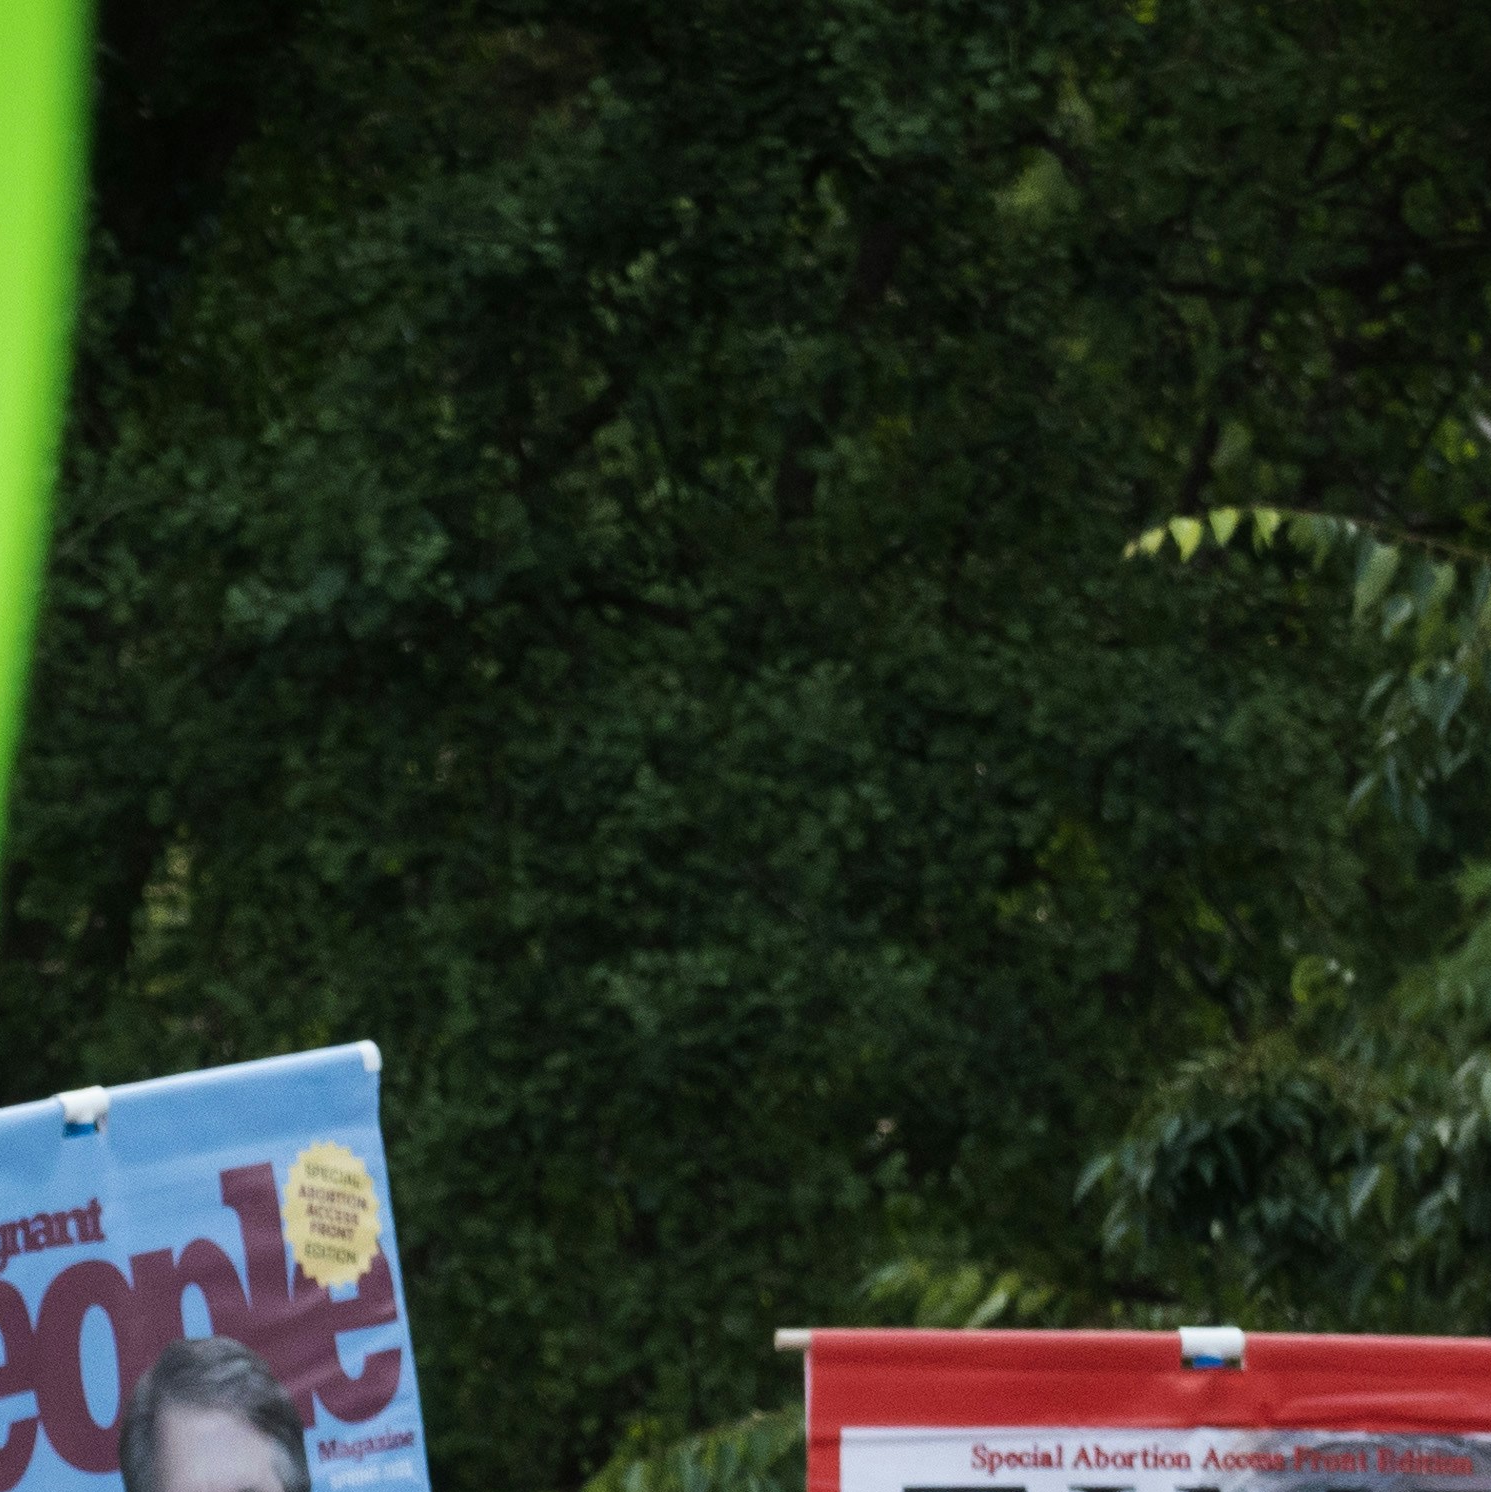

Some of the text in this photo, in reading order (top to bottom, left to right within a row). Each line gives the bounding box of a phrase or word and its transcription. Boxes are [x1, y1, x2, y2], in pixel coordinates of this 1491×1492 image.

[299, 1184, 367, 1211] ABORTION
[306, 1203, 359, 1226] ACCESS
[304, 1241, 357, 1264] EDITION
[318, 1430, 415, 1464] Magazine
[971, 1442, 1473, 1477] Special Abortion Access Front Edition
